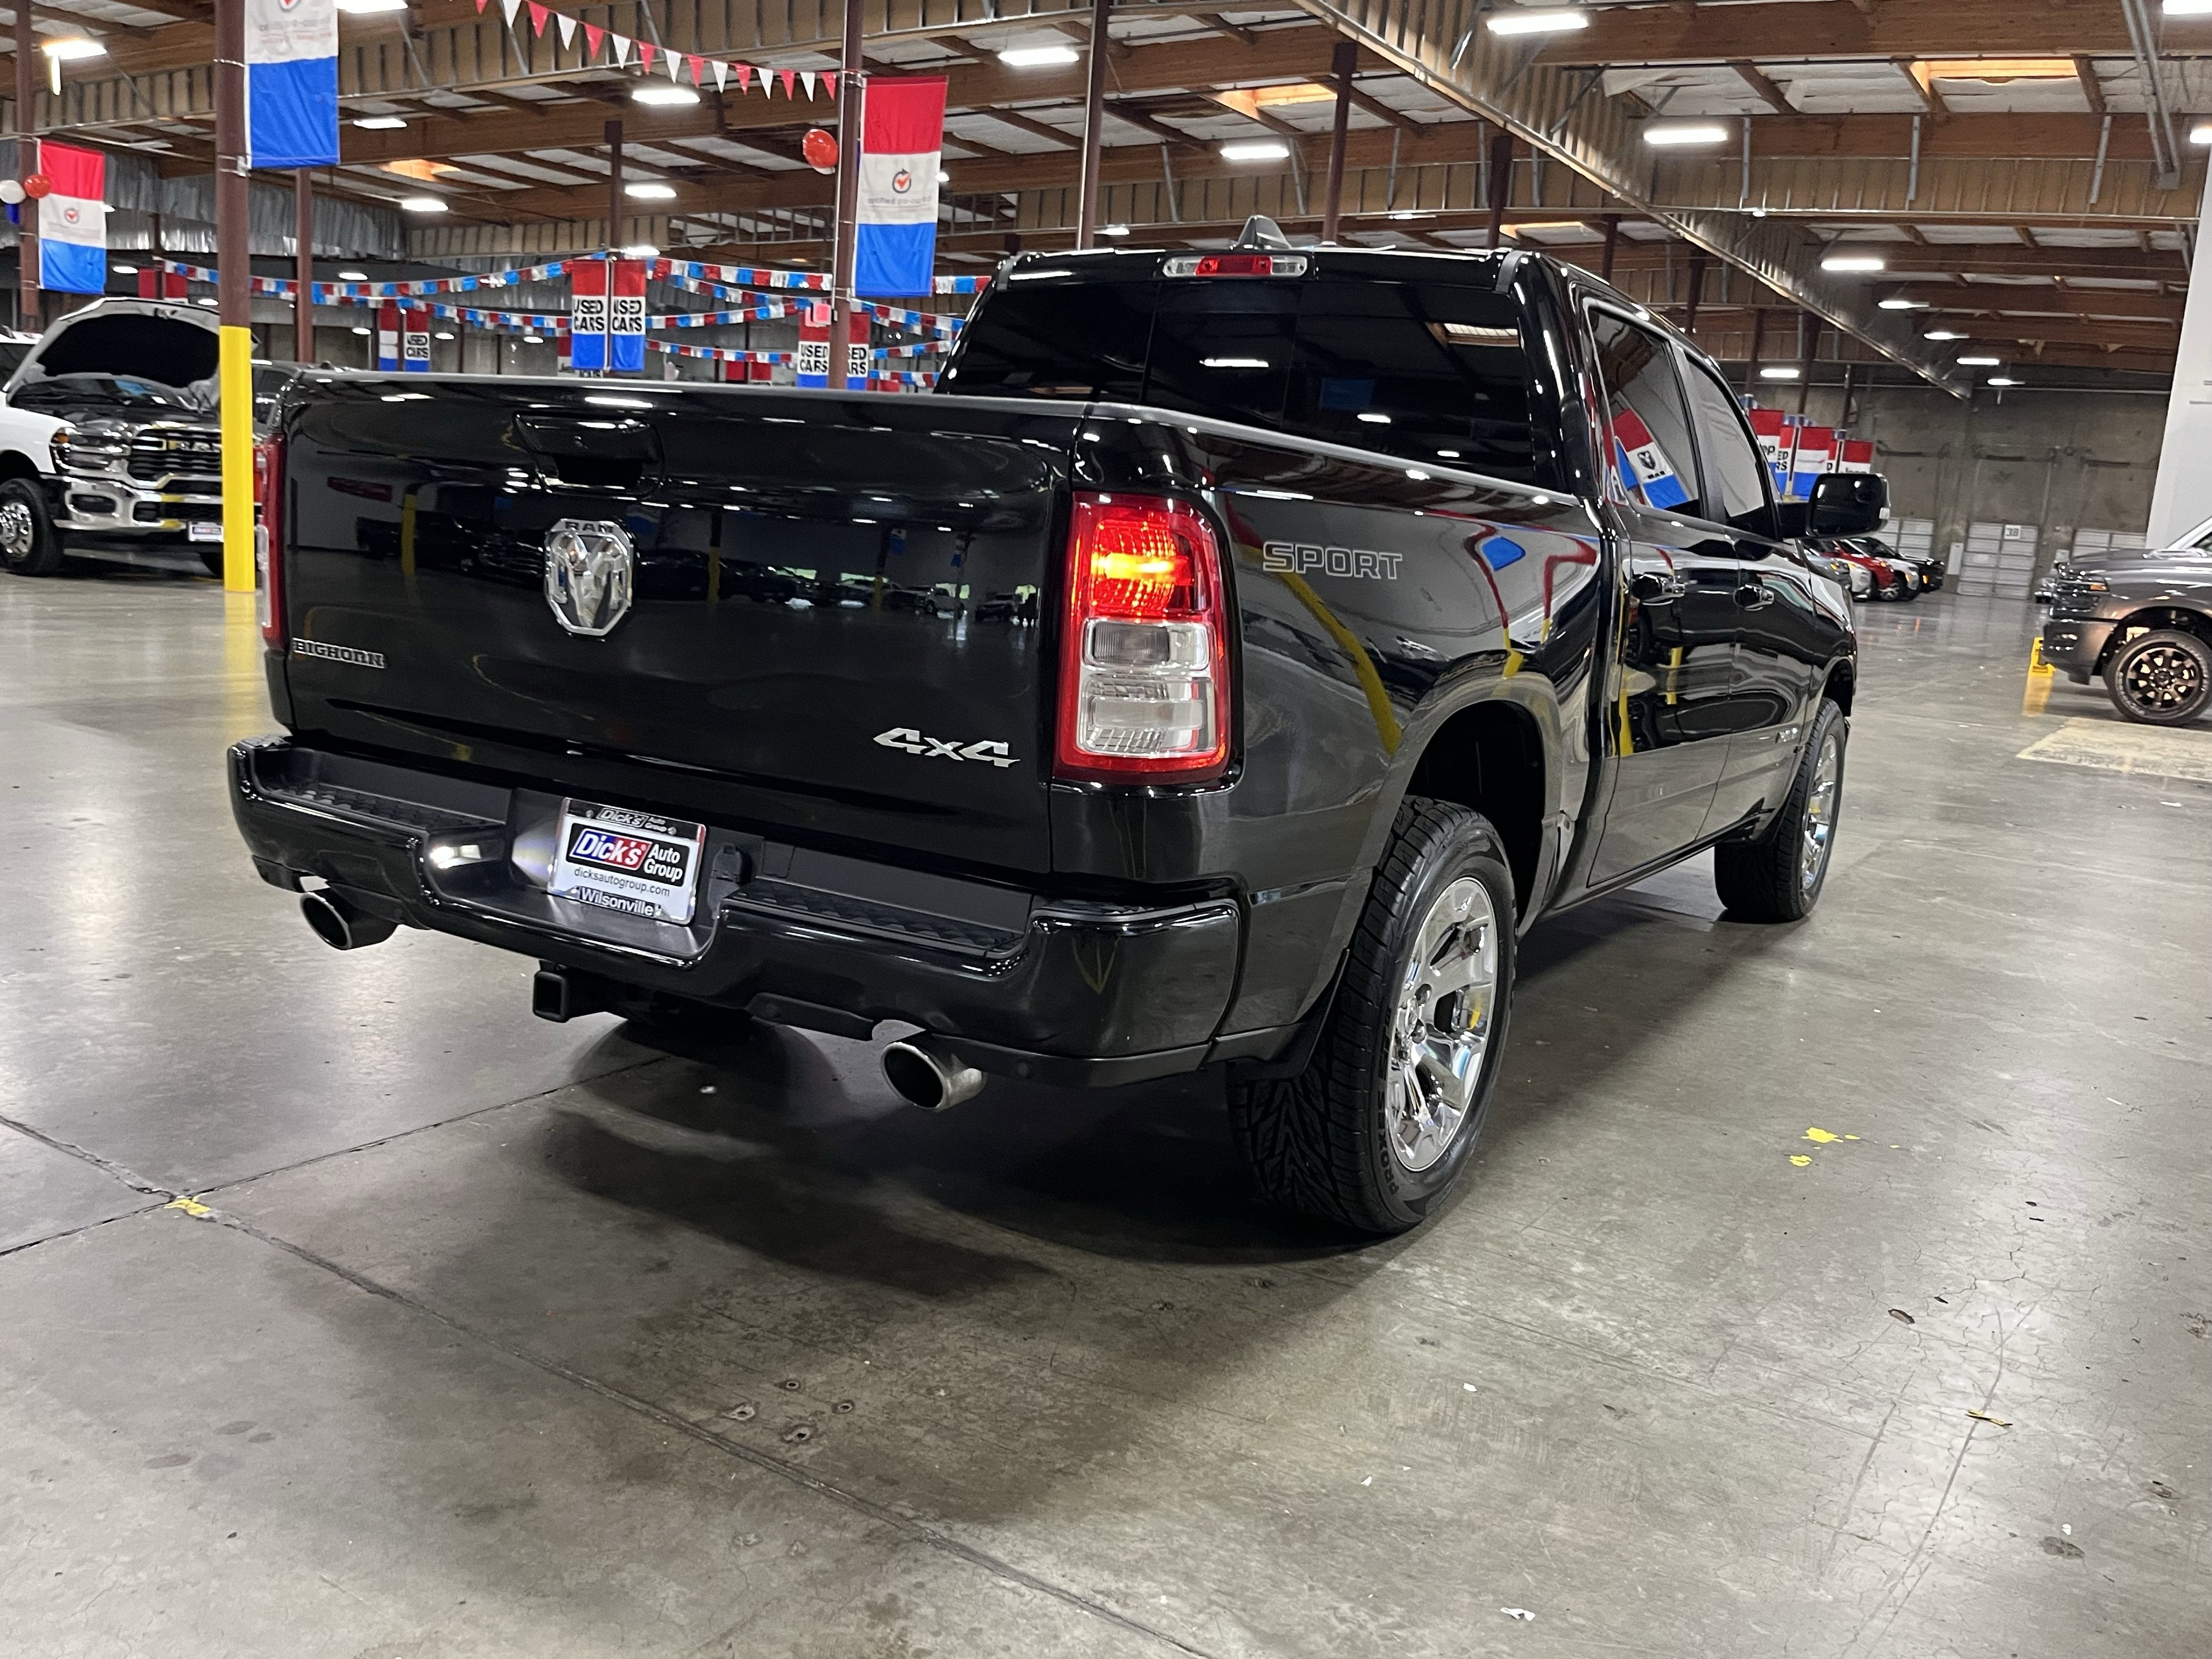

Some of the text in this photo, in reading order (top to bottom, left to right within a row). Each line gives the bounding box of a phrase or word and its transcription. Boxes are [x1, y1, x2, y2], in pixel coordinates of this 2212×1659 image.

[800, 344, 828, 358] USED
[849, 347, 867, 360] ED
[800, 359, 828, 373] CARS
[565, 521, 614, 533] RAM
[1262, 541, 1403, 580] SPORT
[600, 809, 642, 826] Dick's
[575, 831, 681, 866] Dick's Auto
[574, 866, 670, 897] dicksautogroup.com
[644, 860, 684, 883] Group
[581, 887, 654, 917] Wilsonville
[1378, 1090, 1399, 1196] PROXES
